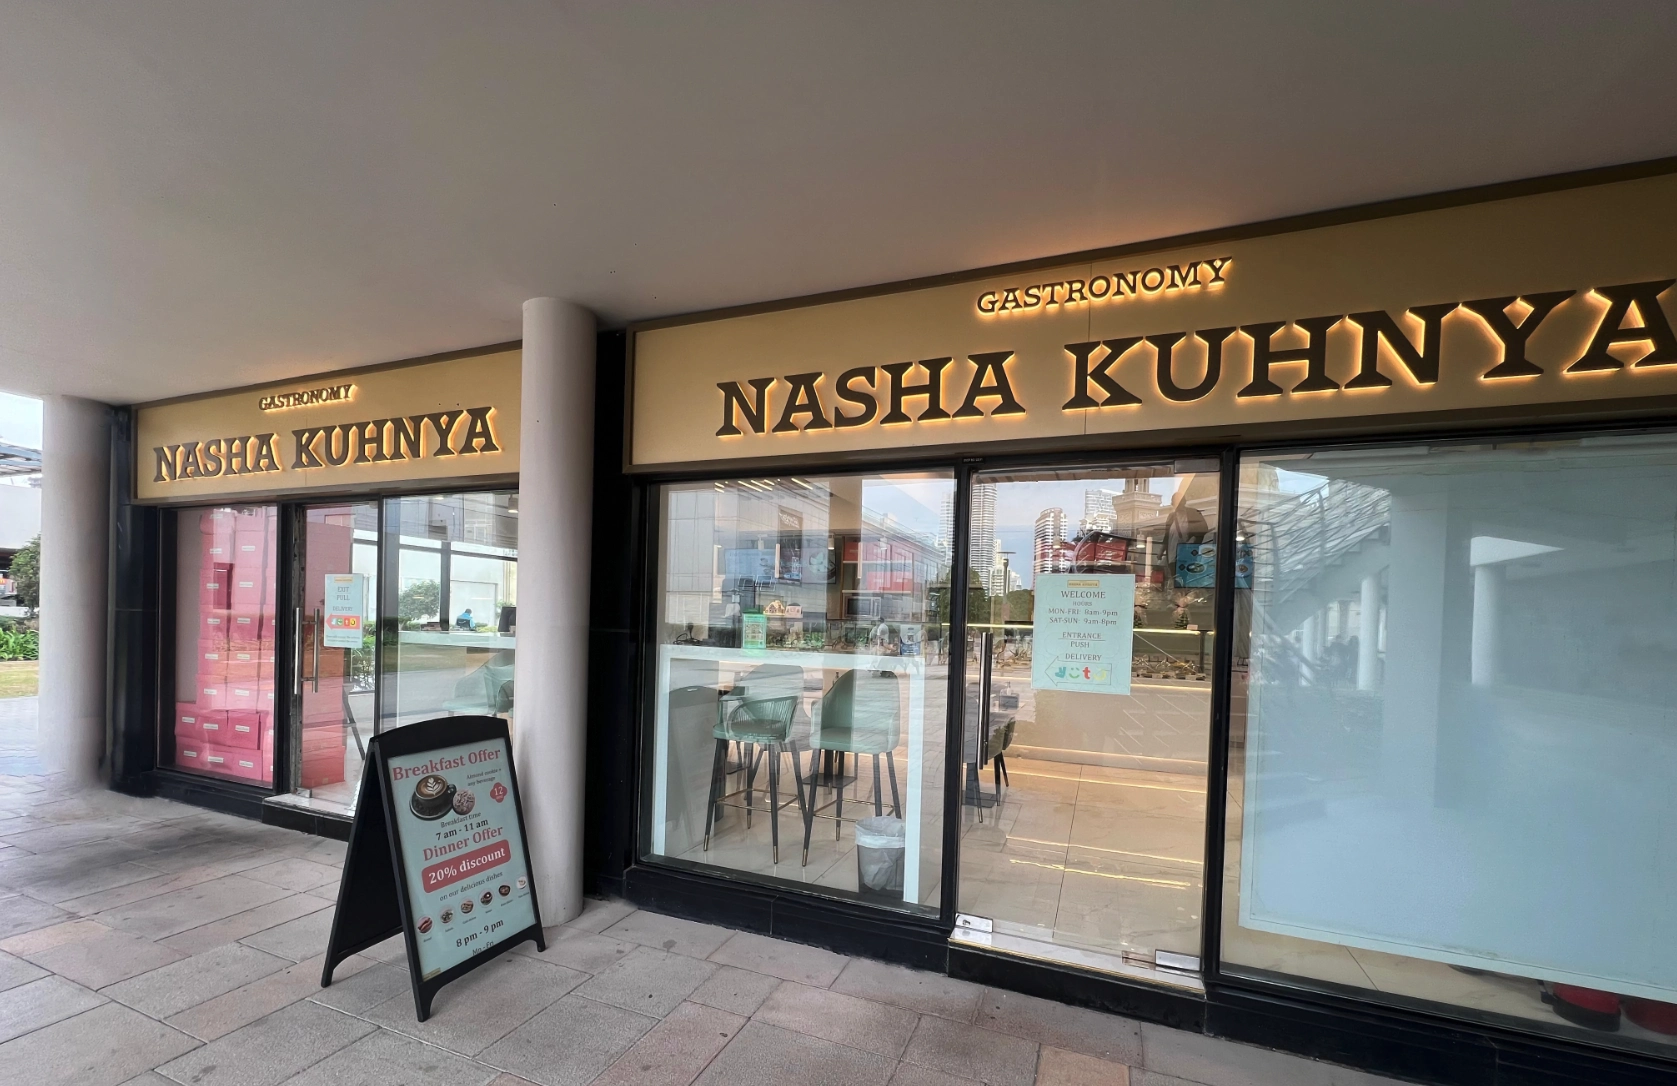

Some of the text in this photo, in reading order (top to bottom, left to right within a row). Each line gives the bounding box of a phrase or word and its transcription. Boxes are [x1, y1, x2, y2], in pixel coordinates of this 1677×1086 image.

[977, 256, 1233, 316] GASTRONOMY
[715, 278, 1677, 438] NASHA KUHNYA
[258, 384, 355, 411] GASTRONOMY
[153, 406, 501, 482] NASHA KUHNYA
[1061, 590, 1106, 599] WELCOME
[1065, 653, 1102, 661] DELIVERY
[392, 748, 501, 781] Breakfast Offer
[494, 786, 504, 796] 12
[435, 832, 442, 841] 7
[443, 829, 457, 839] am
[464, 822, 474, 832] 11
[476, 819, 489, 829] am
[440, 812, 482, 829] Breakfast time
[423, 826, 504, 861] Dinner Offer
[428, 847, 506, 885] 20% discount
[448, 890, 460, 898] our
[460, 878, 486, 893] delicious
[485, 871, 503, 883] dishes
[456, 938, 463, 948] 8
[463, 932, 478, 947] pm
[483, 924, 489, 934] 9
[490, 919, 504, 933] pm
